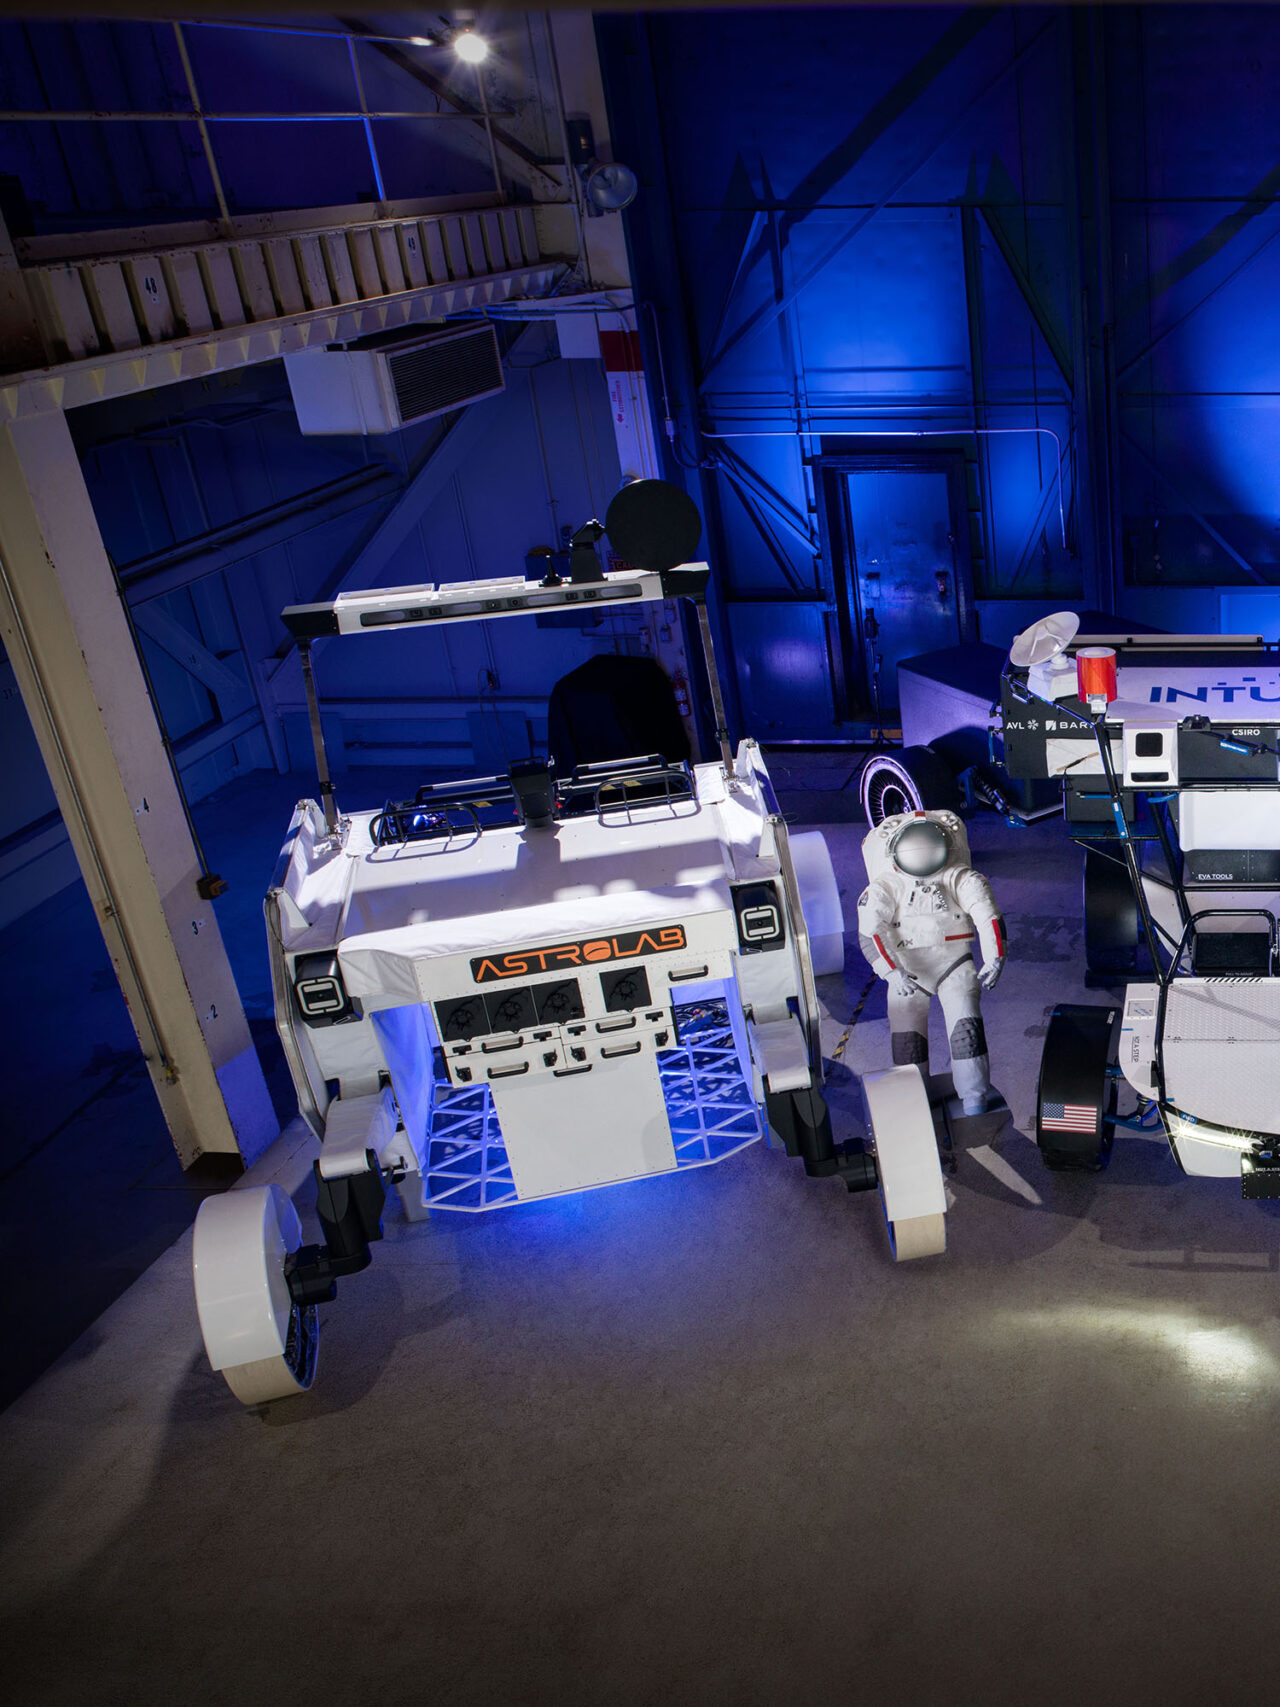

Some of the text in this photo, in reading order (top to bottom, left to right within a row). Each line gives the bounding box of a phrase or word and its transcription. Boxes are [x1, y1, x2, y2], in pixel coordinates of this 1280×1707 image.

[144, 277, 158, 294] 48
[1006, 721, 1025, 730] AVL
[1059, 721, 1095, 729] BAR
[191, 920, 199, 935] 3
[210, 1003, 218, 1019] 2
